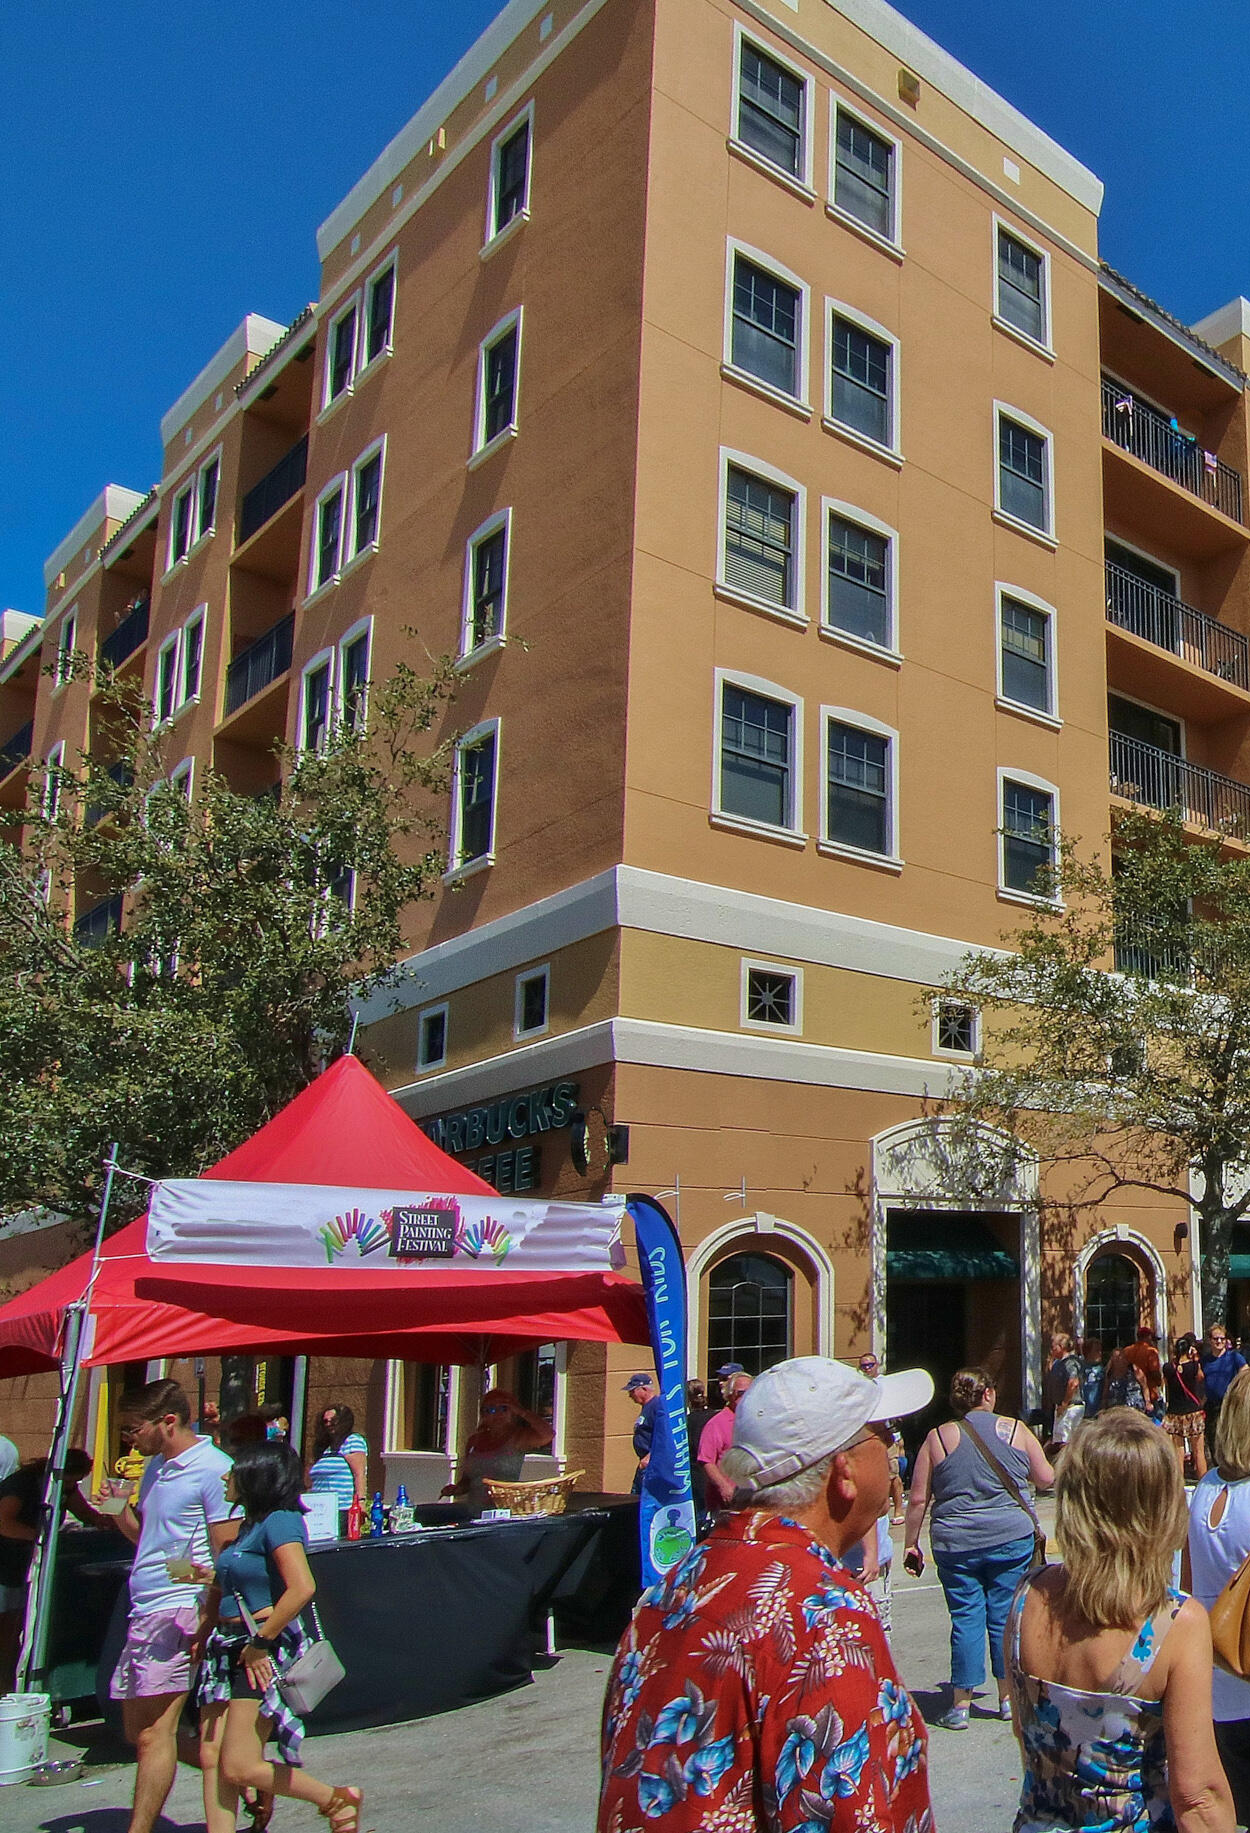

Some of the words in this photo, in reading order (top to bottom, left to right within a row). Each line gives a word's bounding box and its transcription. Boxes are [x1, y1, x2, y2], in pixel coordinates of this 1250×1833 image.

[421, 1081, 577, 1154] ARBUCKS
[399, 1210, 440, 1226] STREET
[399, 1224, 453, 1240] PAINTING
[396, 1237, 448, 1253] FESTIVAL
